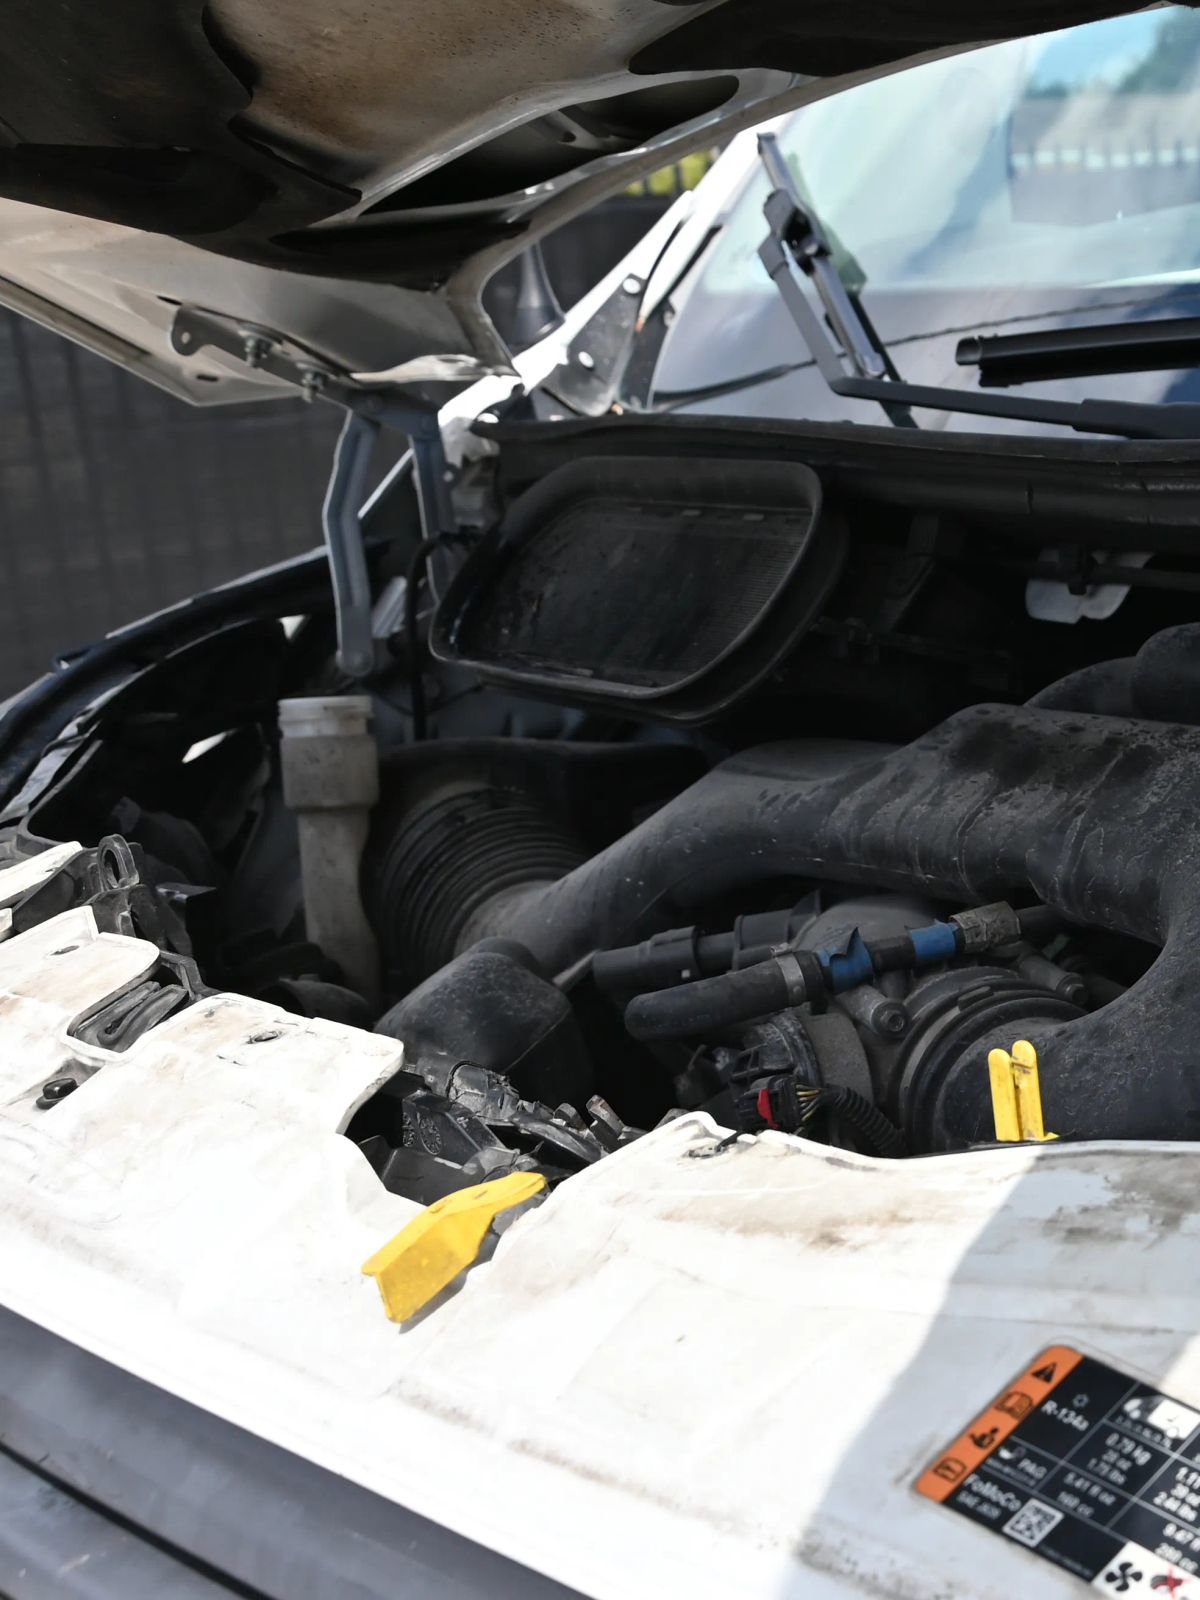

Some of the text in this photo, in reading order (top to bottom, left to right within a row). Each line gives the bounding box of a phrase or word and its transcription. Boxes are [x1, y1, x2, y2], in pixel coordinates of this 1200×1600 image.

[1042, 1400, 1088, 1430] R-134a
[1133, 1446, 1151, 1465] kg
[963, 1472, 1021, 1511] FoMoCo
